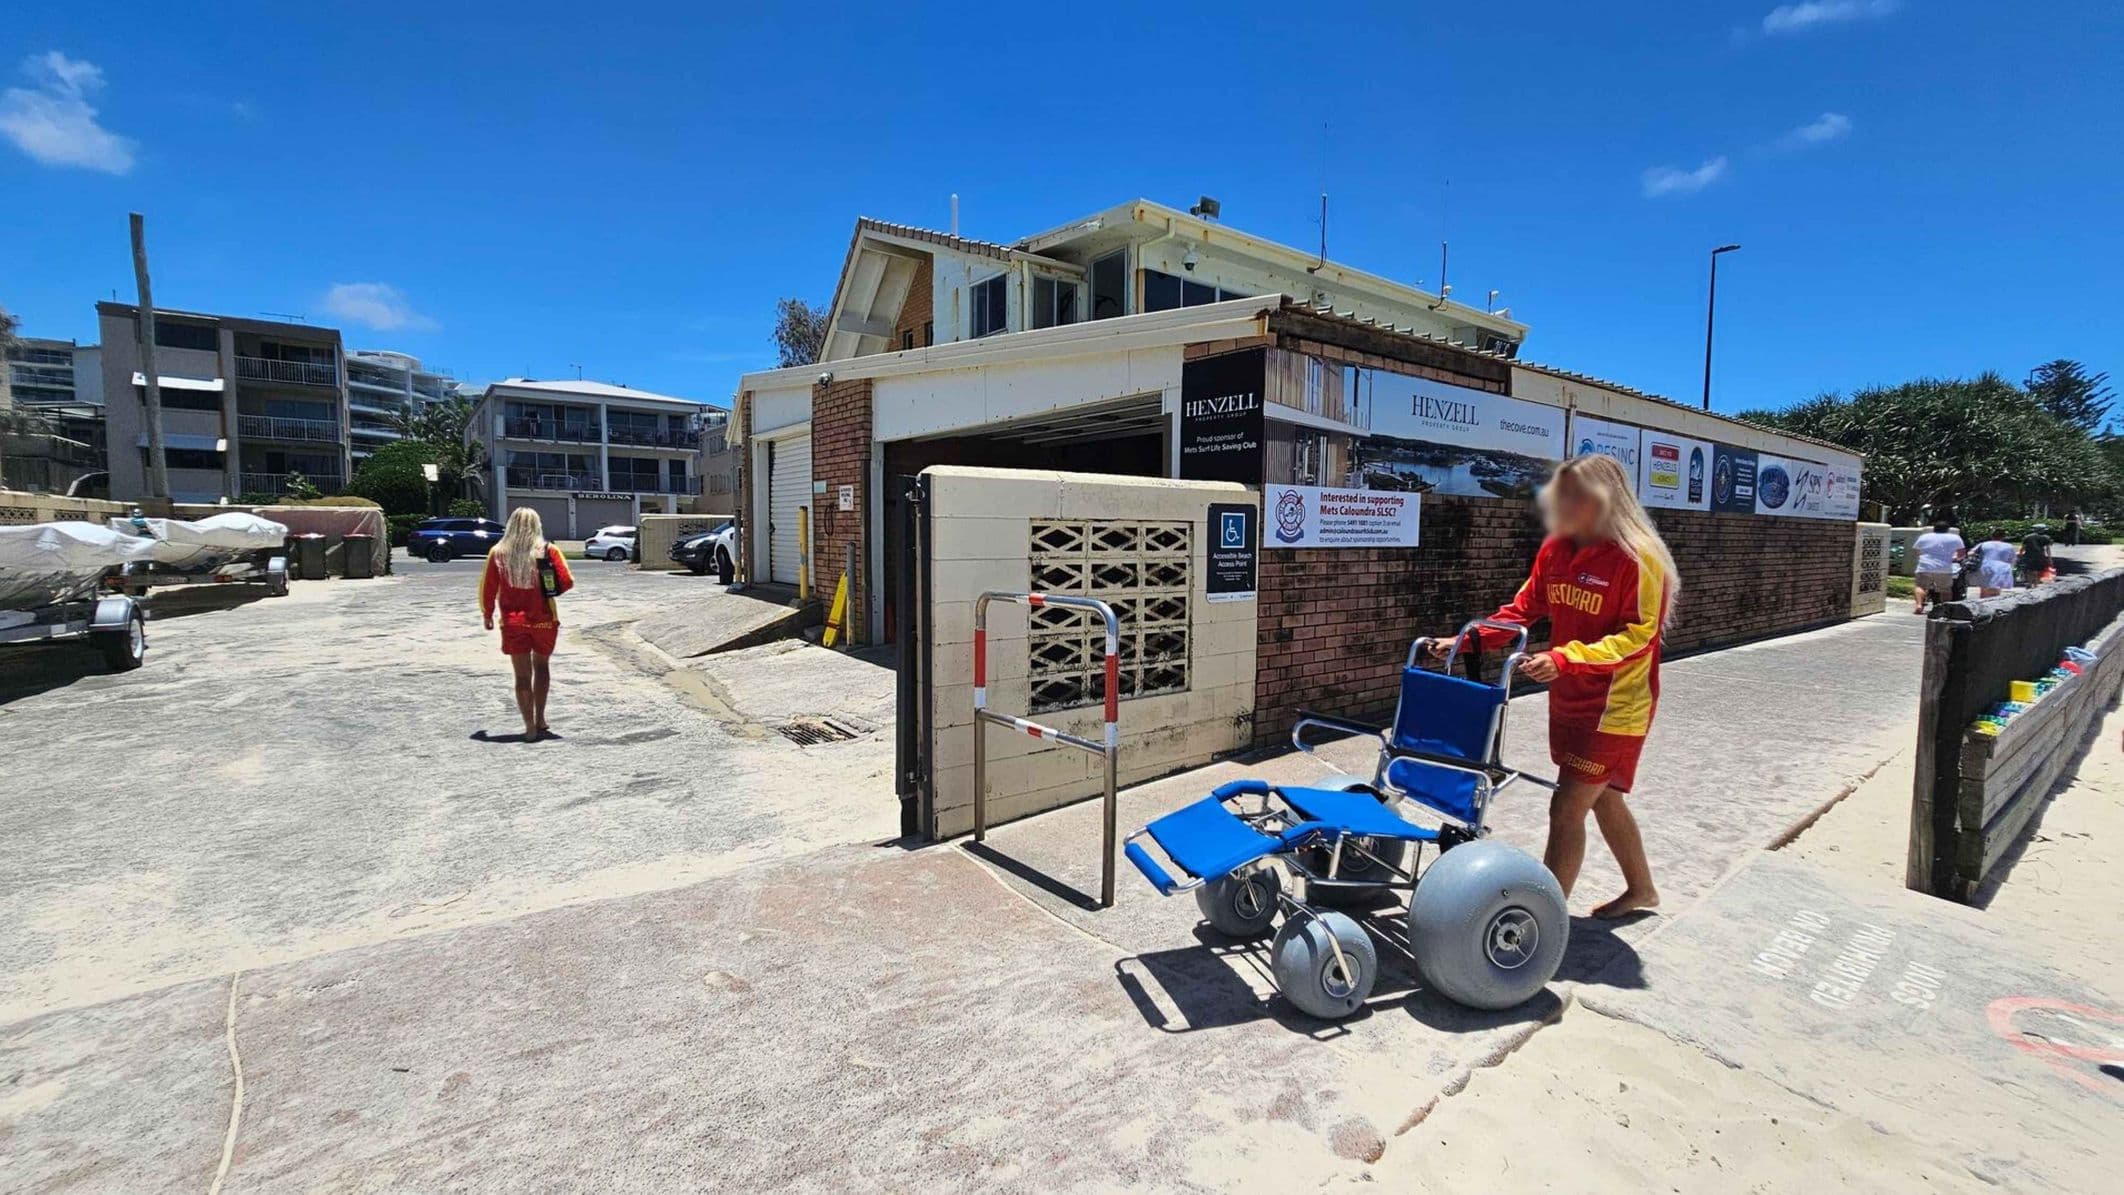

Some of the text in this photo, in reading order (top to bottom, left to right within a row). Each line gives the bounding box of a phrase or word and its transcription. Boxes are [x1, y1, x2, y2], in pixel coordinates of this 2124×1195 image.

[1186, 392, 1259, 417] HENZELL
[1412, 394, 1480, 426] HENZELL
[1500, 418, 1550, 437] thecove.com.au
[1196, 432, 1244, 443] Proud sponsor of
[1184, 441, 1257, 454] Mets Surf Life Saving Club
[1320, 491, 1404, 507] Interested in supporting
[1319, 505, 1397, 517] Mets Caloundra SLSC?
[1212, 552, 1253, 560] Accessible Beach
[1749, 929, 1818, 980] BEACH
[1809, 921, 1897, 1010] PROHIBITED
[1889, 960, 1948, 1010] DOGS
